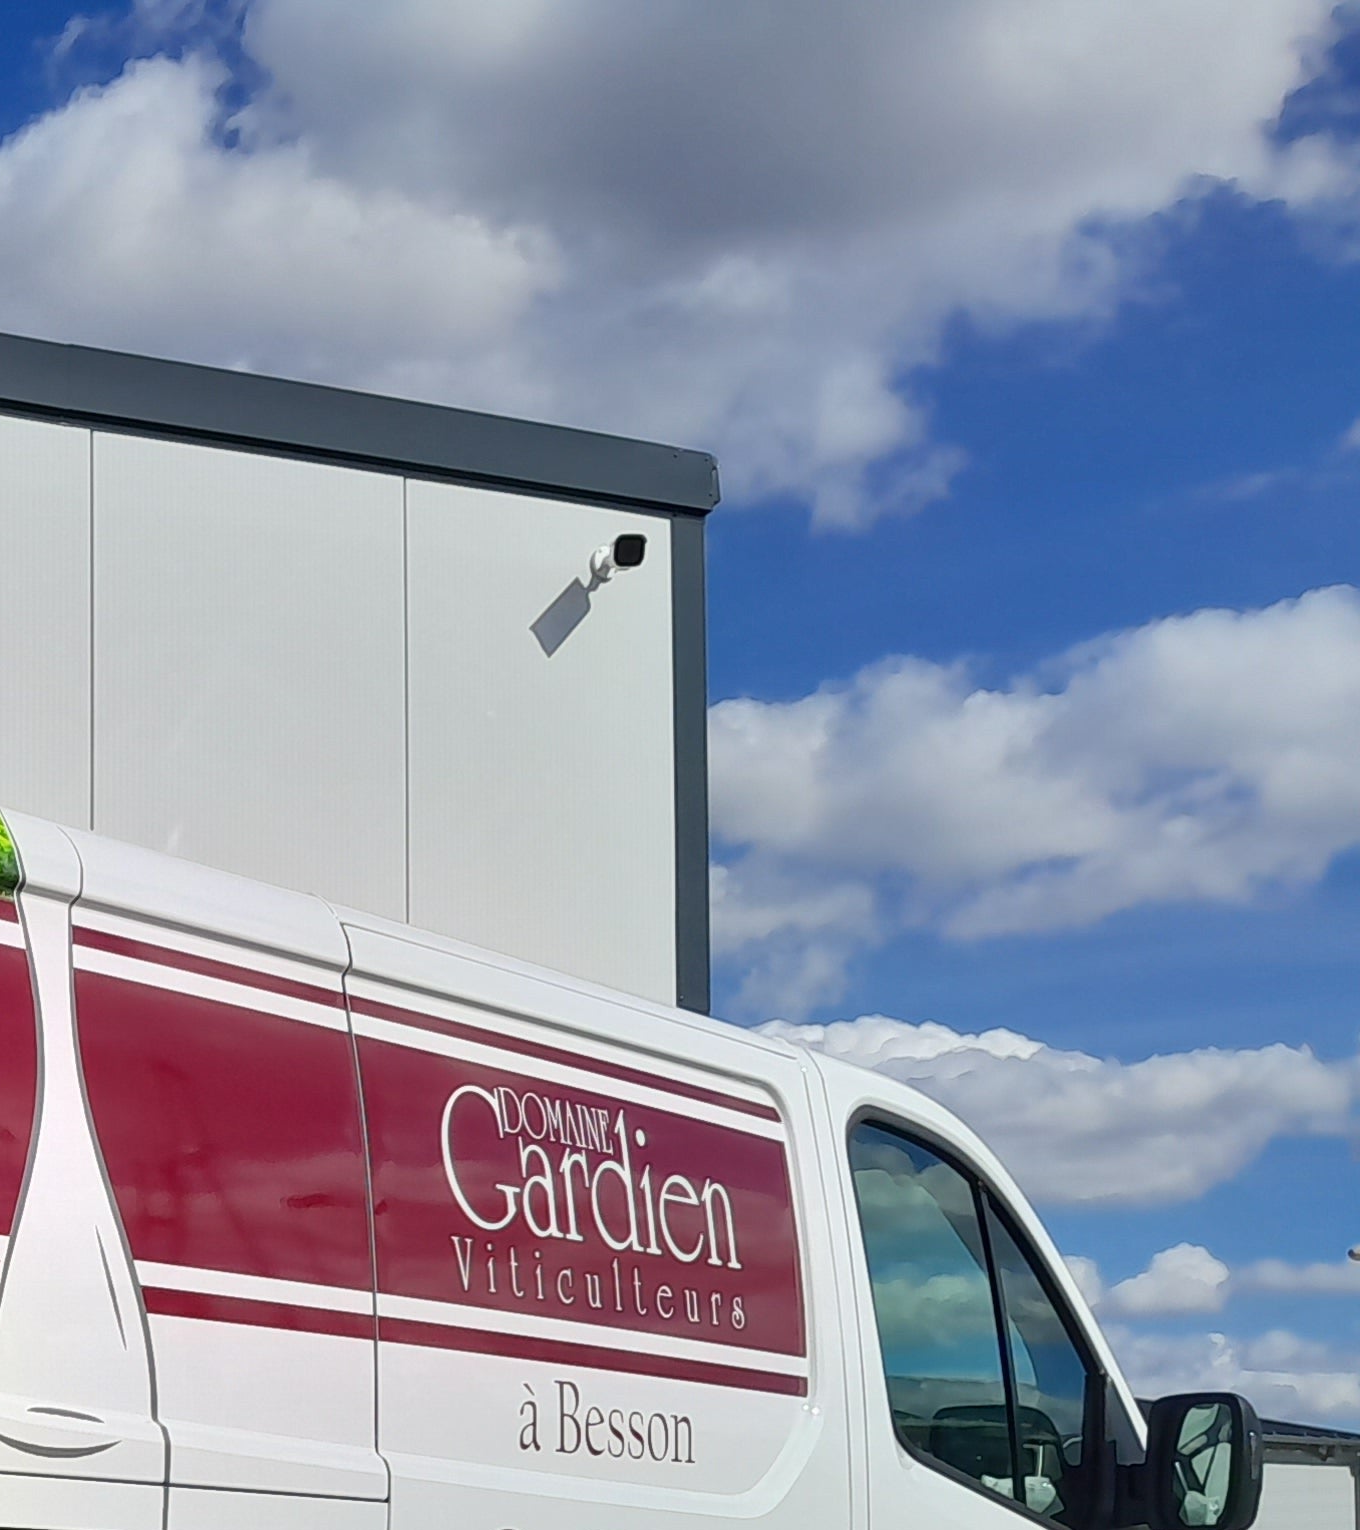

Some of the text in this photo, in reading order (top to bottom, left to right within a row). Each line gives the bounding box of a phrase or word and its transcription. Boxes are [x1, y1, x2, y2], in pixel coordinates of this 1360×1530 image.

[497, 1087, 614, 1155] DOMAINE
[441, 1085, 742, 1269] Gardien
[451, 1236, 746, 1329] Viticulteurs
[519, 1380, 696, 1464] à Besson
